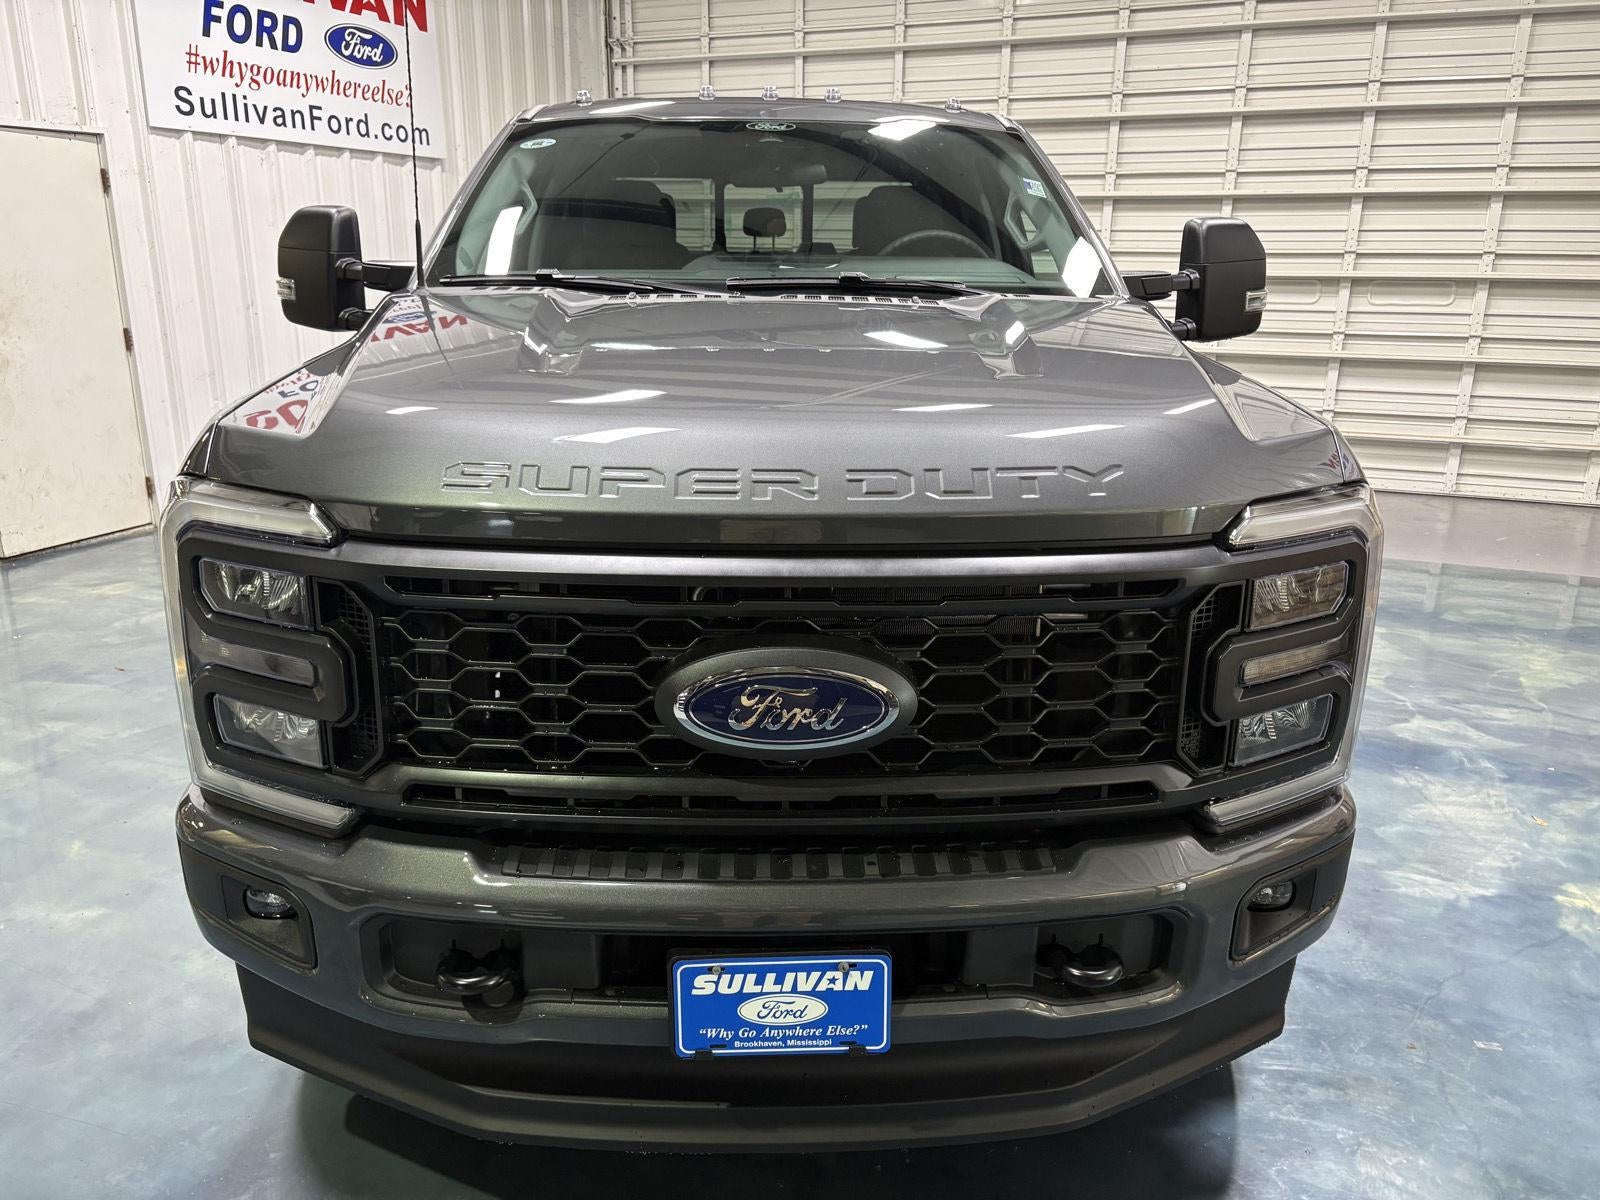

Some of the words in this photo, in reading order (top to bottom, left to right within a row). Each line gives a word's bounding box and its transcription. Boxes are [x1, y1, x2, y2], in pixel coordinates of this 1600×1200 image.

[202, 0, 303, 53] FORD
[341, 28, 384, 63] Ford
[174, 85, 430, 147] SullivanFord.com
[441, 461, 819, 500] SUPER
[845, 464, 1124, 500] DUTY
[728, 684, 848, 731] Ford
[691, 970, 874, 995] SULLIVAN
[757, 1000, 808, 1020] Ford
[734, 1040, 785, 1048] Brookhaven,
[787, 1039, 832, 1047] Mississippi
[738, 1027, 757, 1038] Go
[760, 1025, 823, 1040] Anywhere
